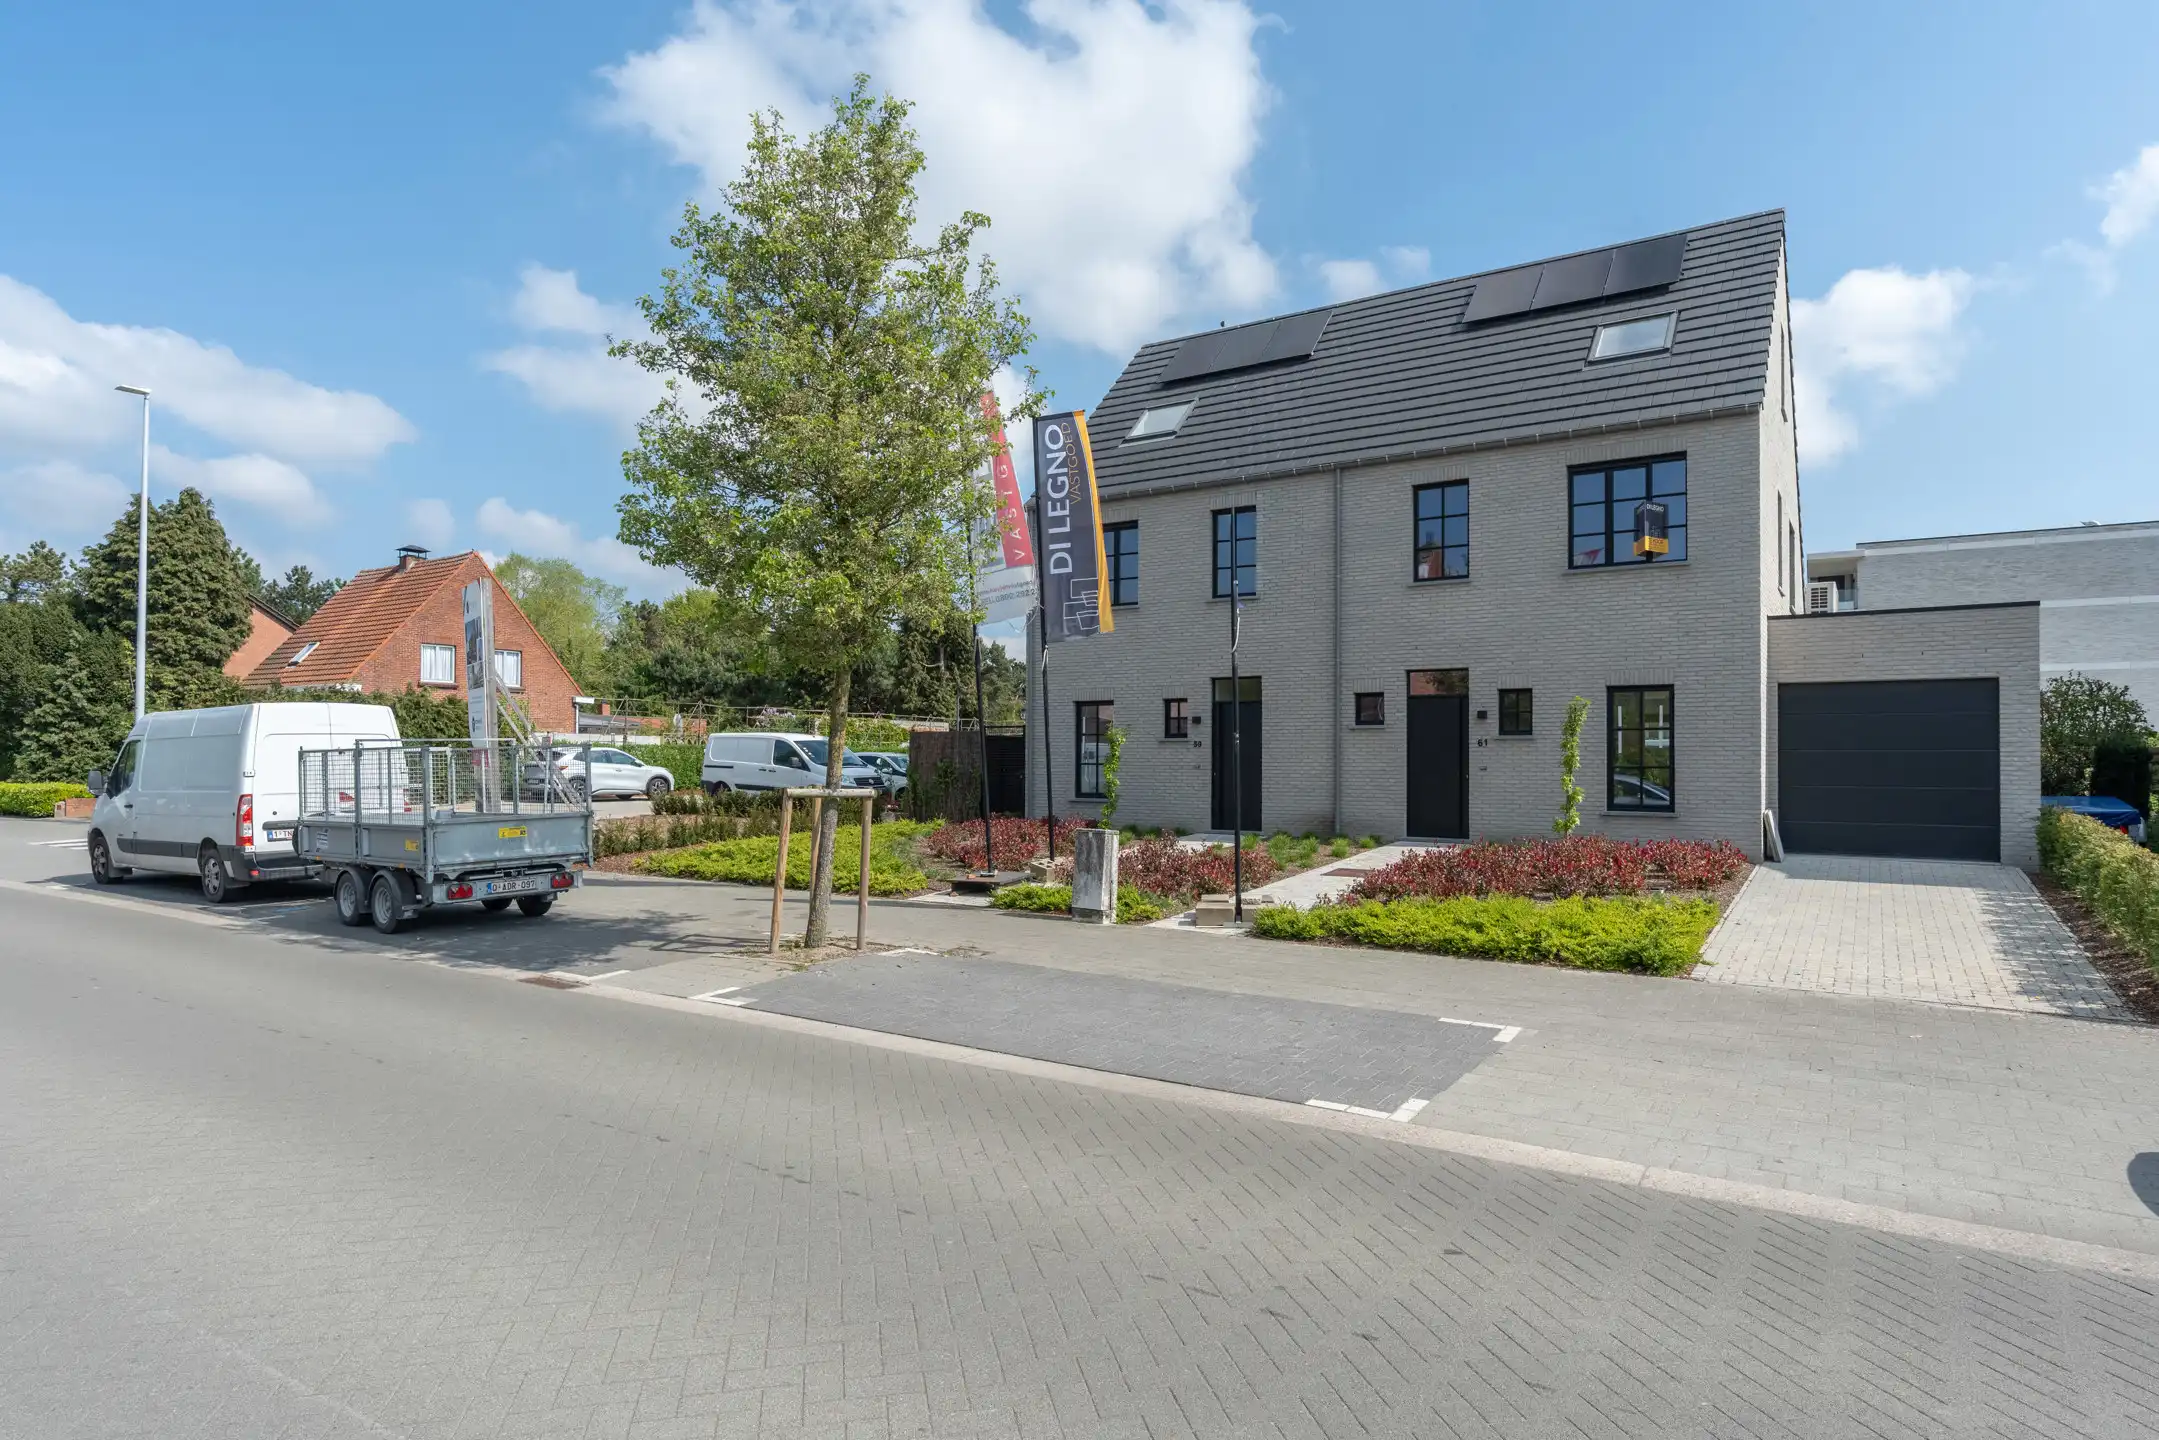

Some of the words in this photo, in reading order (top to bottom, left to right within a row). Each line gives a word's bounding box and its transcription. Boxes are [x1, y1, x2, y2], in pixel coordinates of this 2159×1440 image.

[1044, 424, 1071, 534] LEGNO
[1060, 422, 1082, 505] VASTGOED
[1049, 541, 1073, 575] DI
[1477, 738, 1488, 747] 61
[274, 830, 293, 838] 1-TN
